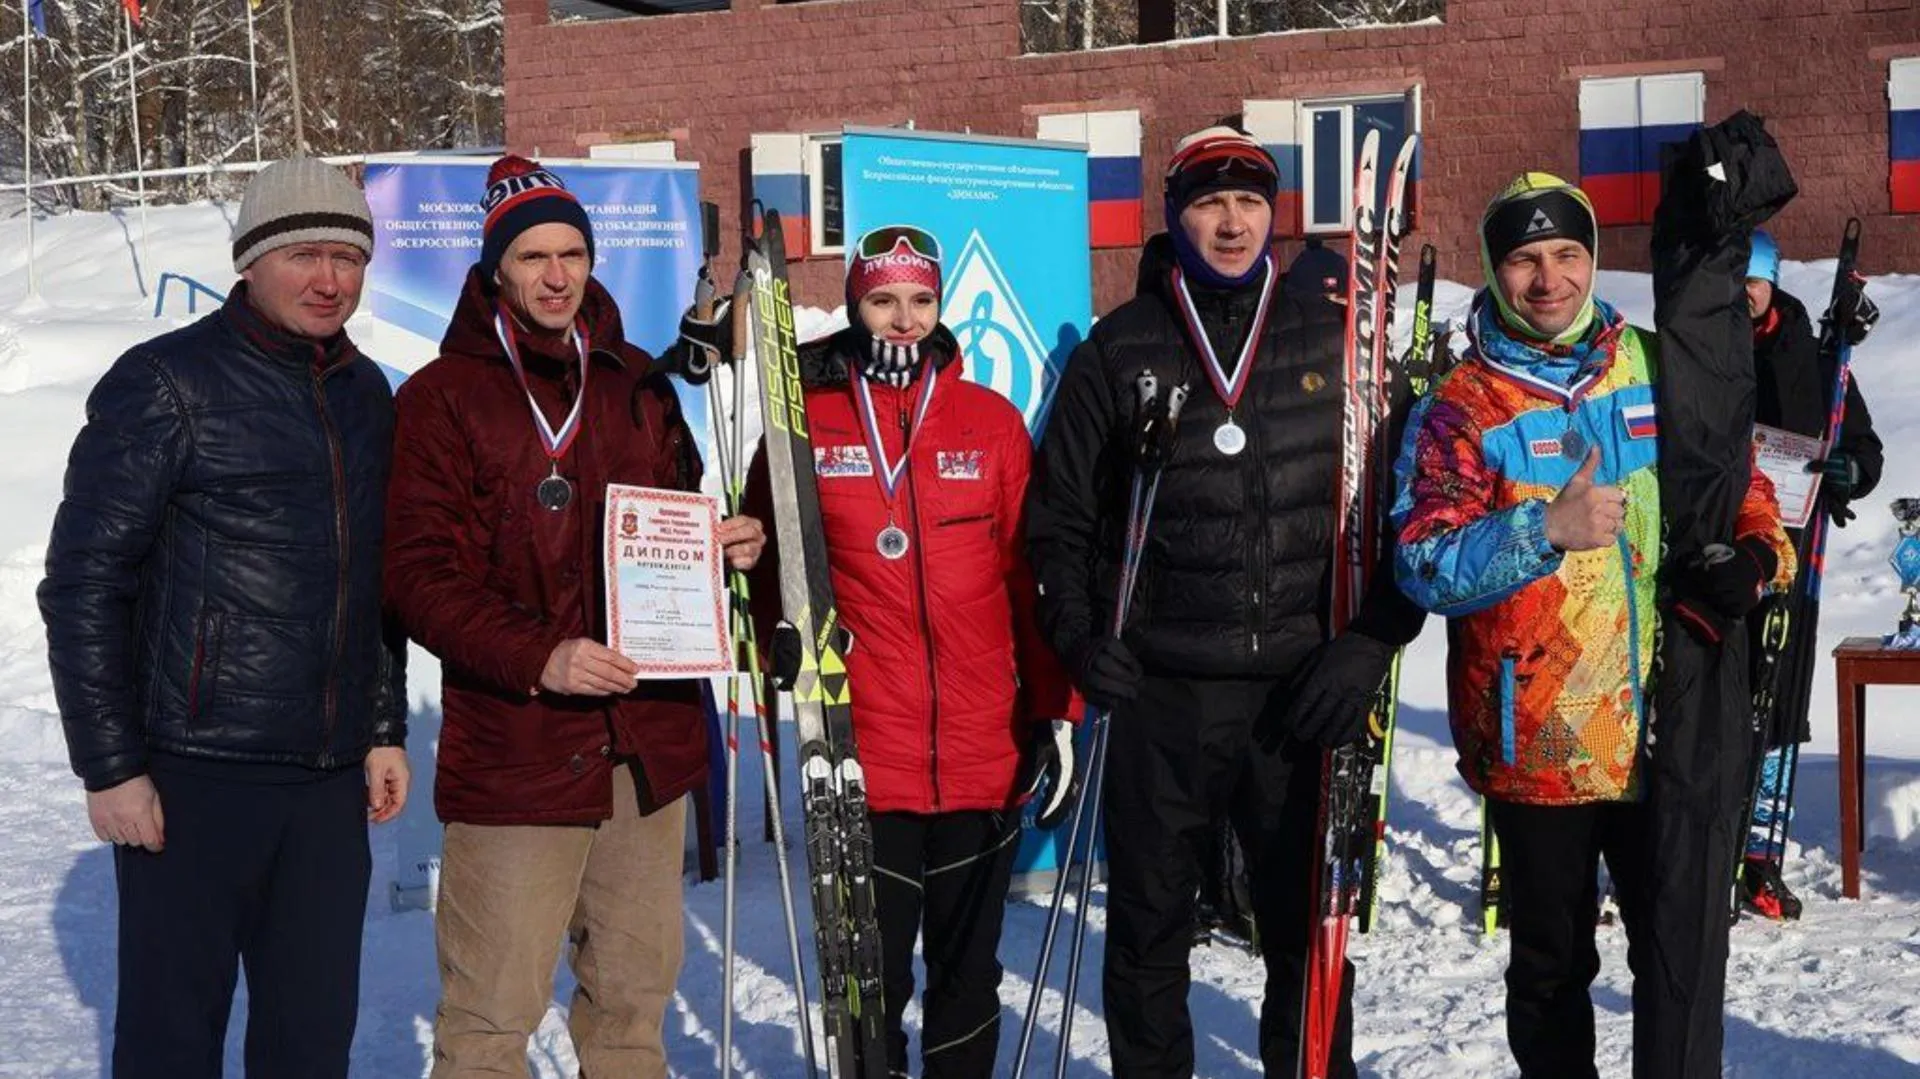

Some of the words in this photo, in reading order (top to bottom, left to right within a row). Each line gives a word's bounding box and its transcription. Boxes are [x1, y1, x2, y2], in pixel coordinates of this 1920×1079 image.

[863, 169, 925, 182] Всероссийское
[418, 203, 485, 214] МОСКОВСК
[583, 203, 657, 215] РГАНИЗАЦИЯ
[385, 220, 483, 232] ОБЩЕСТВЕННО-
[605, 220, 687, 231] ОБЪЕДИНЕНИЯ
[391, 236, 483, 249] «ВСЕРОССИЙСК
[605, 238, 684, 250] СПОРТИВНОГО
[1353, 206, 1376, 404] ATOMIC
[755, 267, 788, 432] FISCHER
[773, 277, 808, 438] FISCHER
[623, 545, 704, 562] ДИПЛОМ
